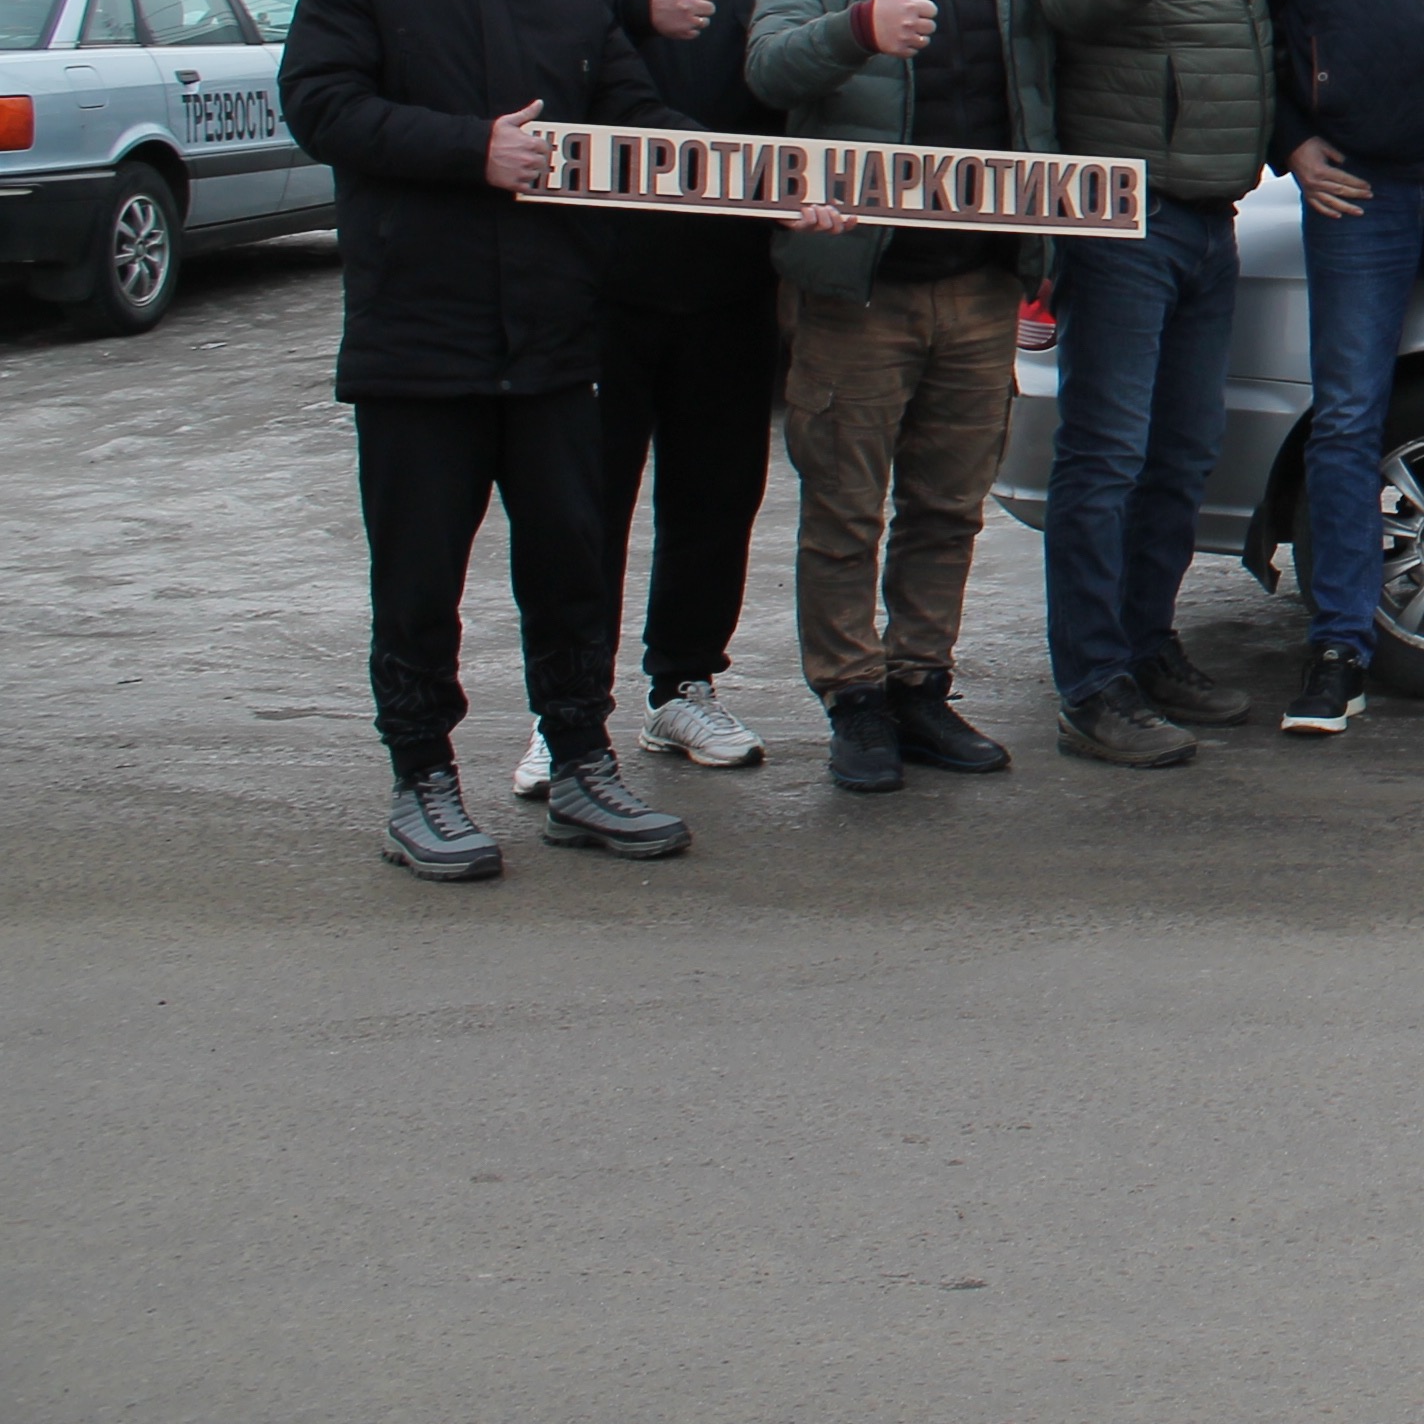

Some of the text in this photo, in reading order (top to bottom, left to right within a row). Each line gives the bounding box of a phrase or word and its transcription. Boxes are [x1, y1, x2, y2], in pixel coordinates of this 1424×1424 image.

[182, 90, 276, 144] ТРЕЗВОСТЬ
[611, 135, 809, 208] ПРОТИВ
[824, 147, 1139, 226] НАРКОТИКОВ
